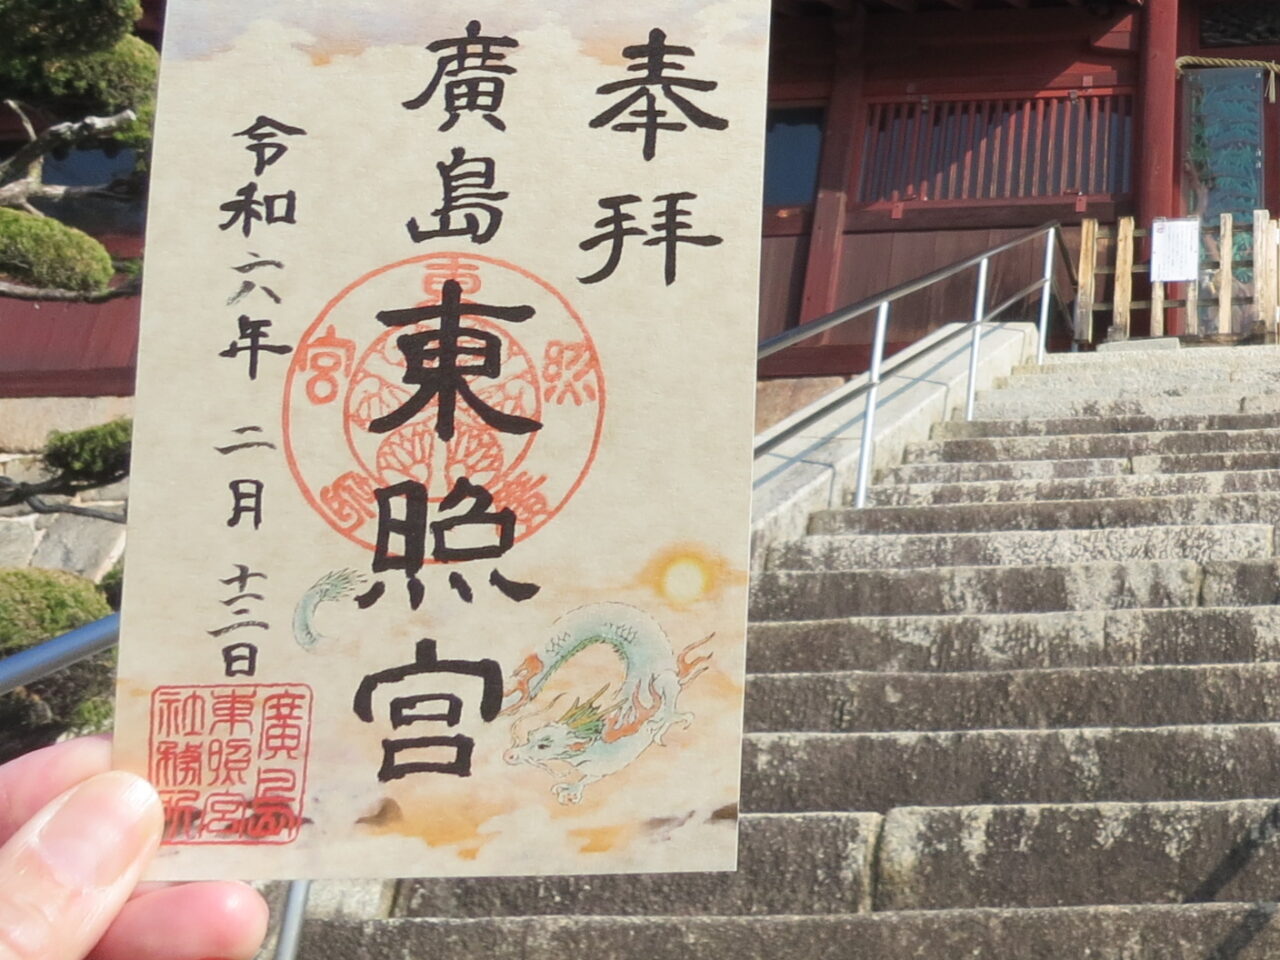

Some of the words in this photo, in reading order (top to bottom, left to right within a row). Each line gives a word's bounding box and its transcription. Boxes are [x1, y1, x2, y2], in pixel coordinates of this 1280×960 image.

[353, 19, 543, 783] 廣島東照宮
